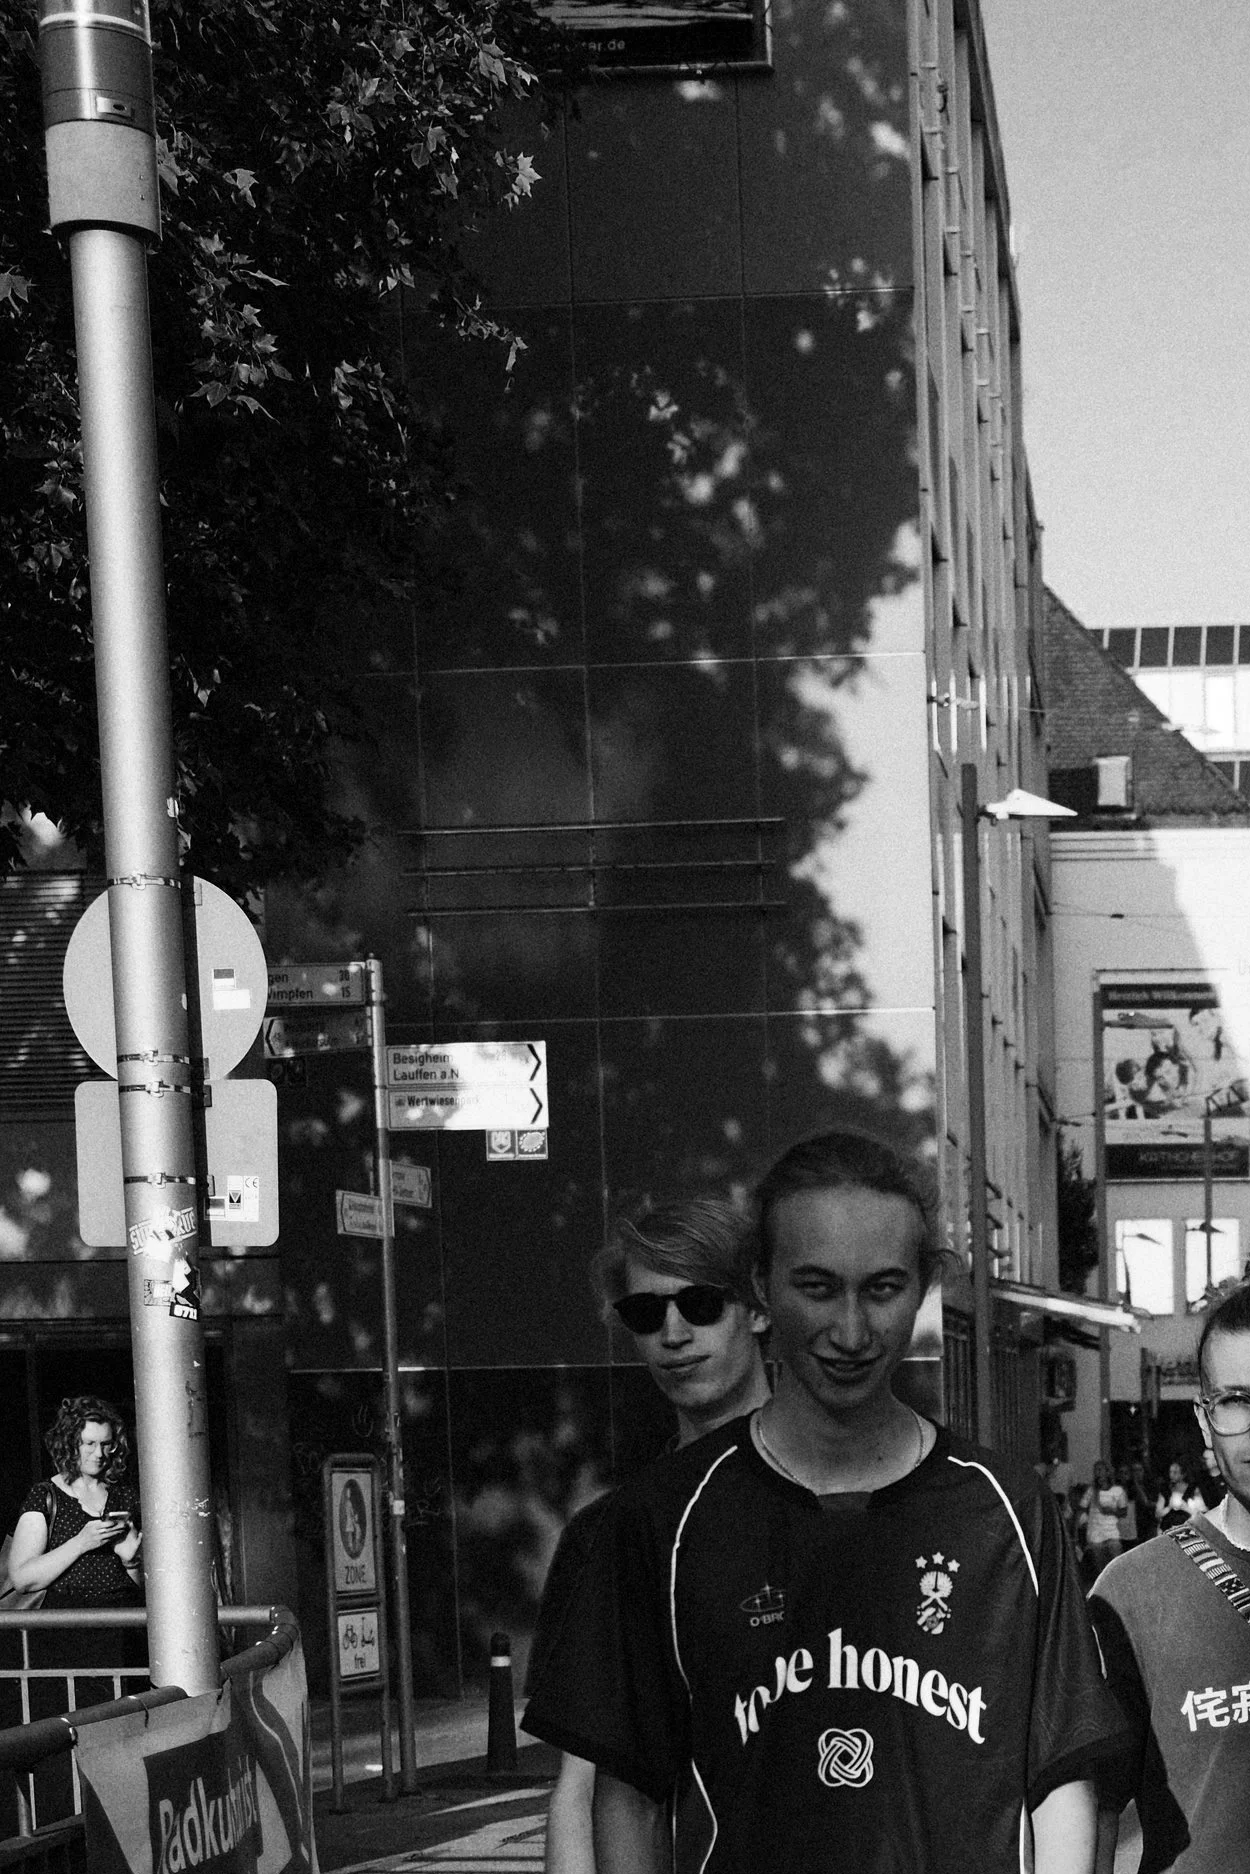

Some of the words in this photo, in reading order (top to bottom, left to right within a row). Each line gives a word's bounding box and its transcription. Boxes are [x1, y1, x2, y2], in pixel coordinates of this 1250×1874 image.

[342, 986, 351, 998] 15
[393, 1069, 437, 1081] Lauffen
[344, 1564, 367, 1585] ZONE
[354, 1652, 367, 1669] frei
[827, 1628, 988, 1745] honest
